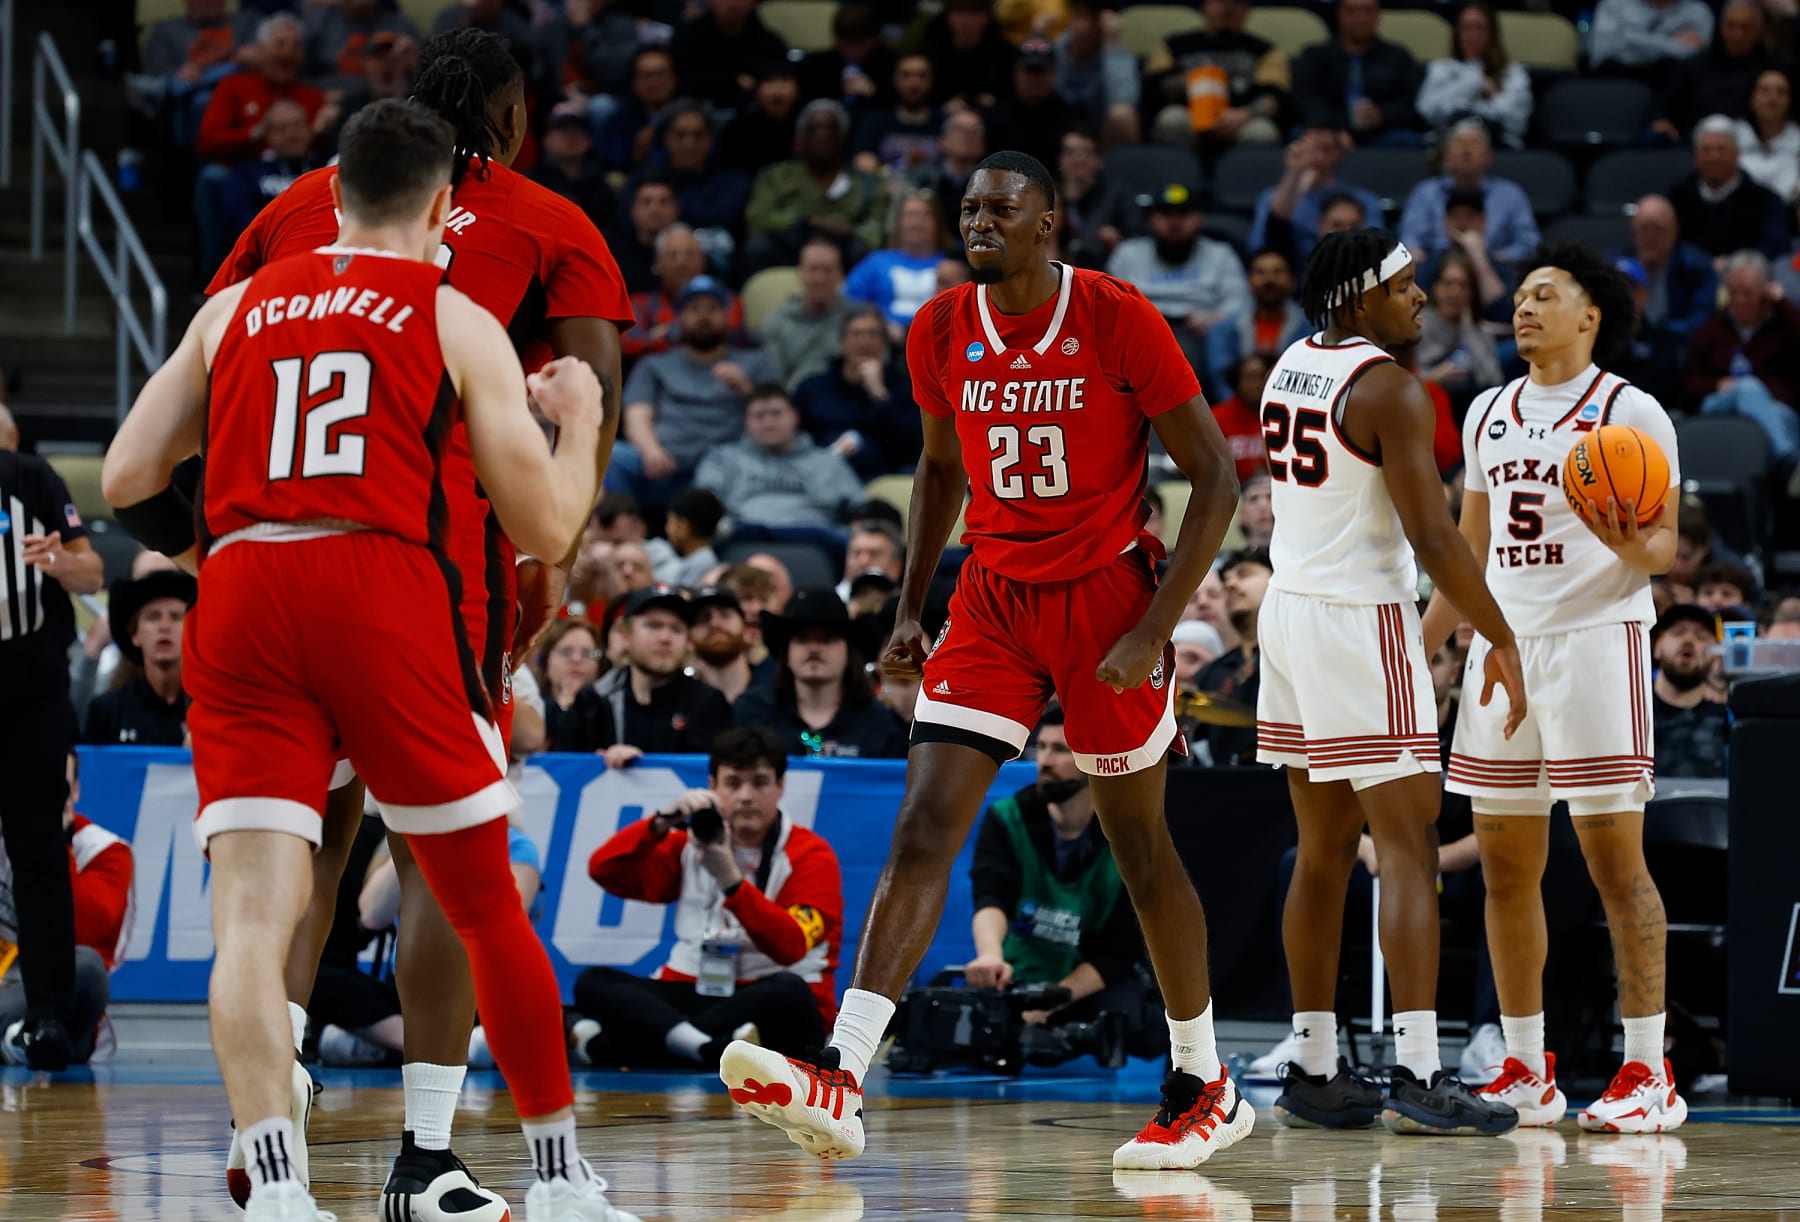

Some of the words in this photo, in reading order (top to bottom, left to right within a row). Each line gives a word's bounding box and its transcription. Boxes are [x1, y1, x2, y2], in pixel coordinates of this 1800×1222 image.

[245, 286, 414, 337] O'CONNELL
[960, 379, 998, 412] NC
[1000, 377, 1086, 413] STATE
[1272, 368, 1322, 397] JENNINGS
[1319, 377, 1334, 400] II
[268, 350, 374, 480] 12
[986, 424, 1070, 499] 23
[1262, 401, 1330, 488] 25
[1576, 441, 1597, 487] NCAA
[1488, 459, 1560, 488] TEXA
[1507, 491, 1546, 541] 5
[1496, 544, 1564, 568] TECH
[1096, 755, 1130, 774] PACK
